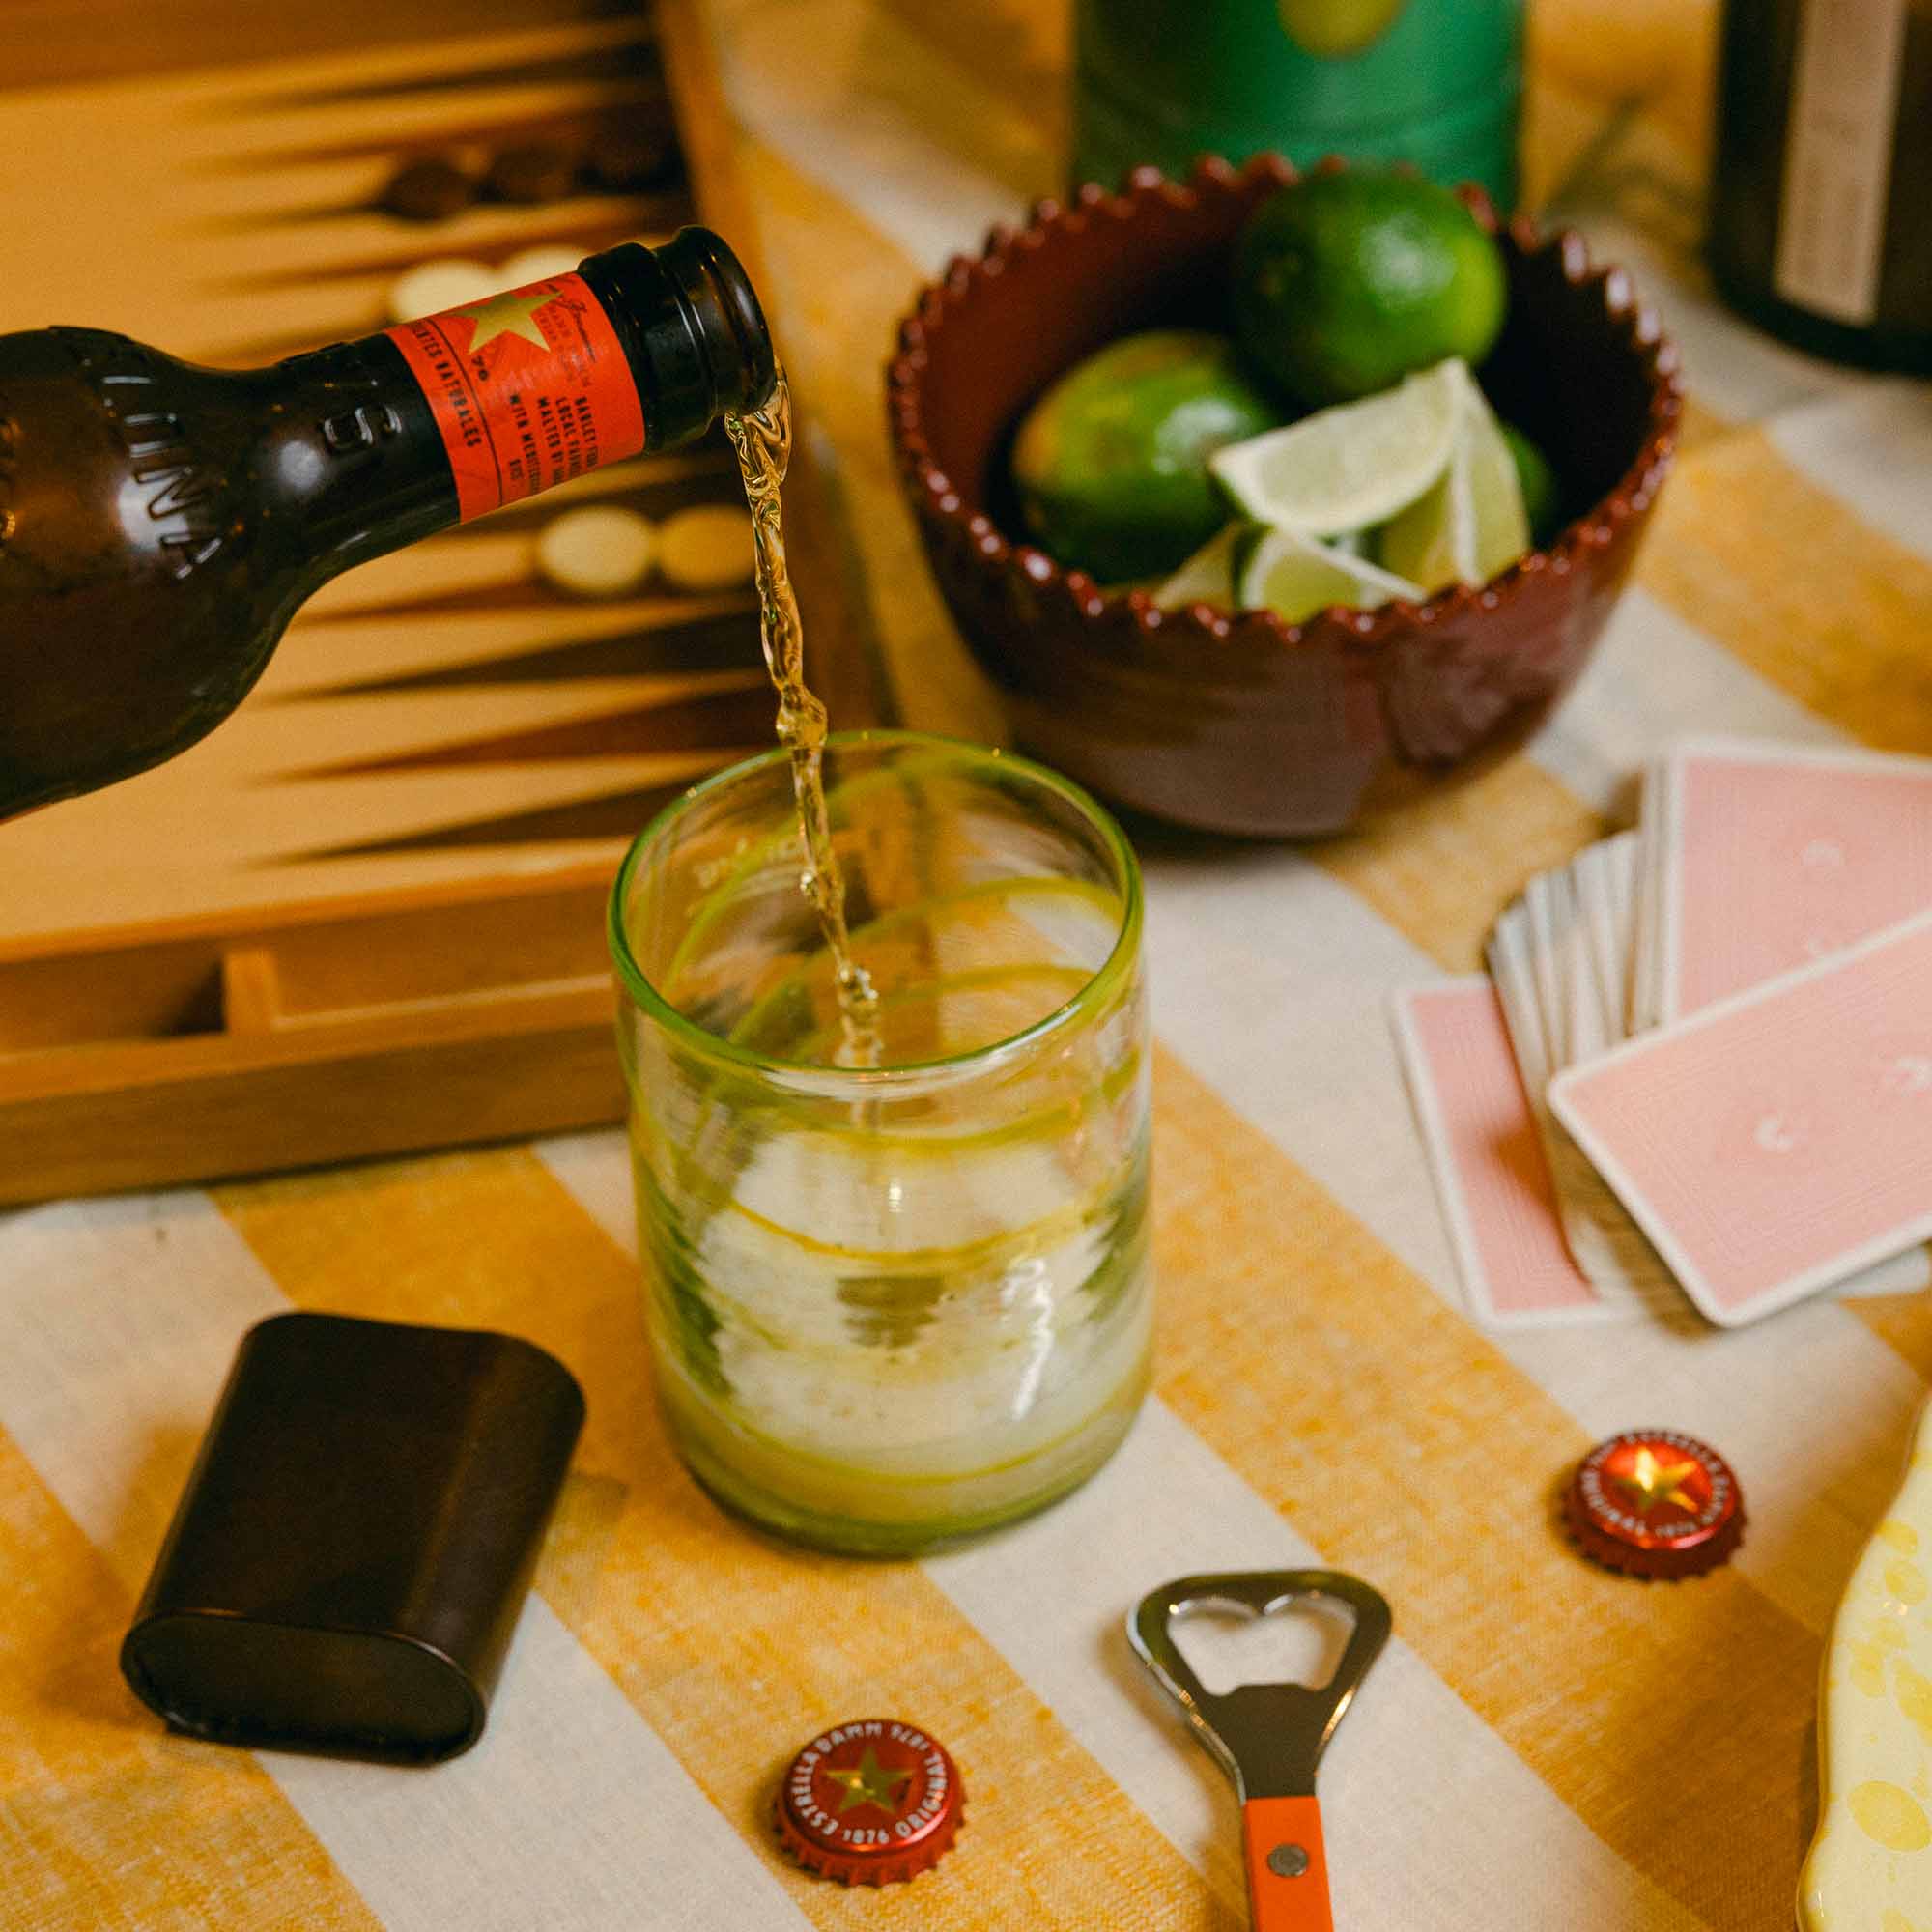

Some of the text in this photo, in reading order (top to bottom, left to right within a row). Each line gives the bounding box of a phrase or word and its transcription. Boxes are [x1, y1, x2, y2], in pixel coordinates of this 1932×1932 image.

[435, 361, 481, 447] NATURALES
[537, 396, 562, 449] MALTED
[555, 396, 577, 438] LOCAL
[575, 396, 597, 443] BARLEY
[790, 1721, 883, 1836] ESTRELLA DAMM
[895, 1751, 948, 1839] ORIGINAL
[841, 1828, 891, 1845] 1876
